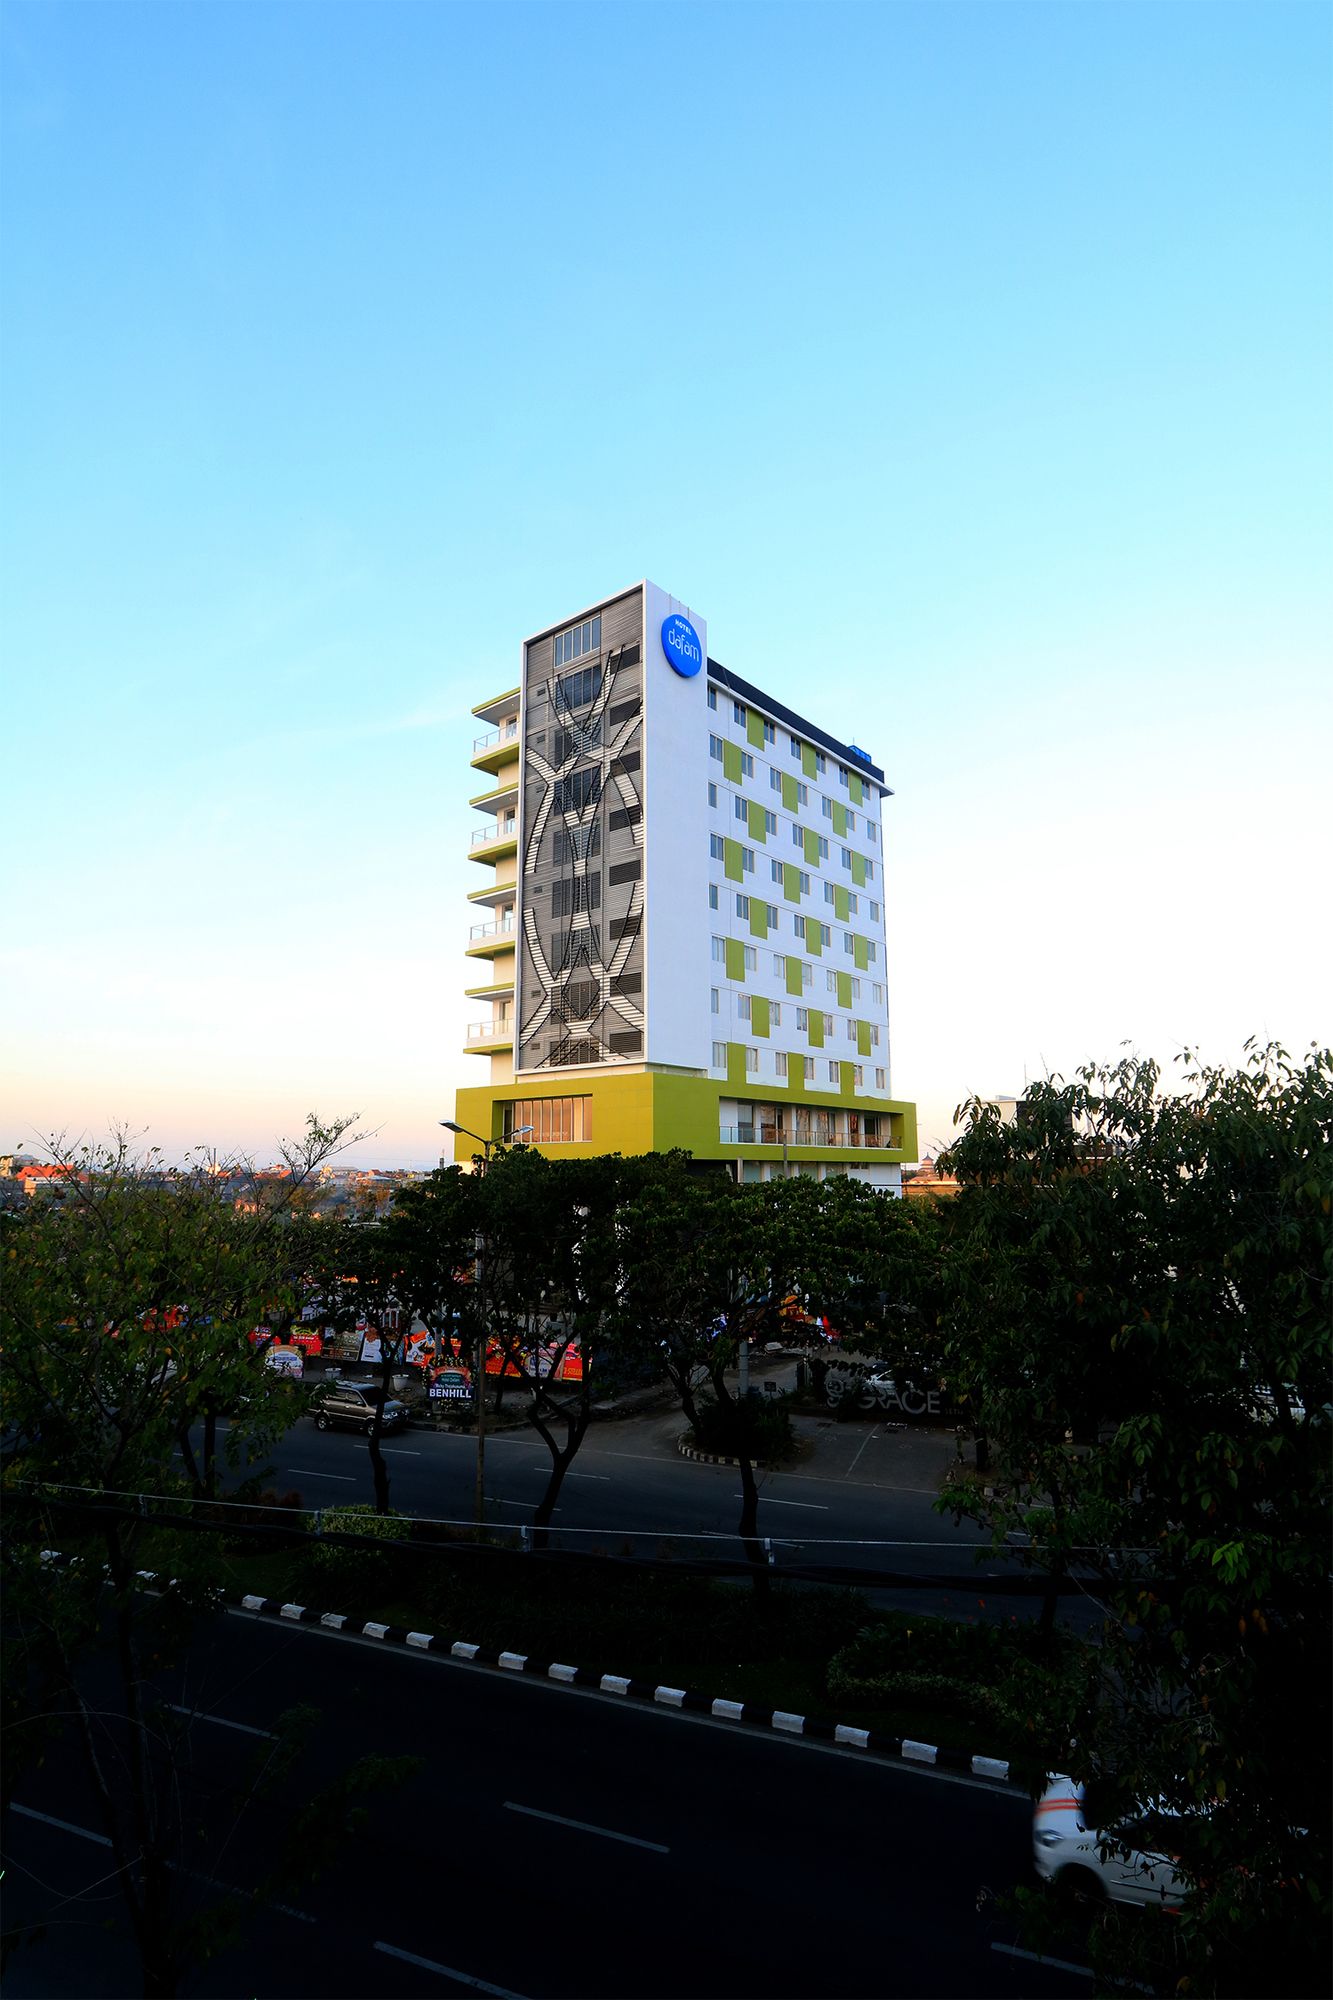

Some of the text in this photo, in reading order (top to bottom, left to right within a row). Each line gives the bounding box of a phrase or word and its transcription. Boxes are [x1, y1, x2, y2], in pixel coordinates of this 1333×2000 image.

[674, 619, 692, 636] HOTEL
[668, 628, 700, 662] dafam
[429, 1388, 472, 1399] BENHILL
